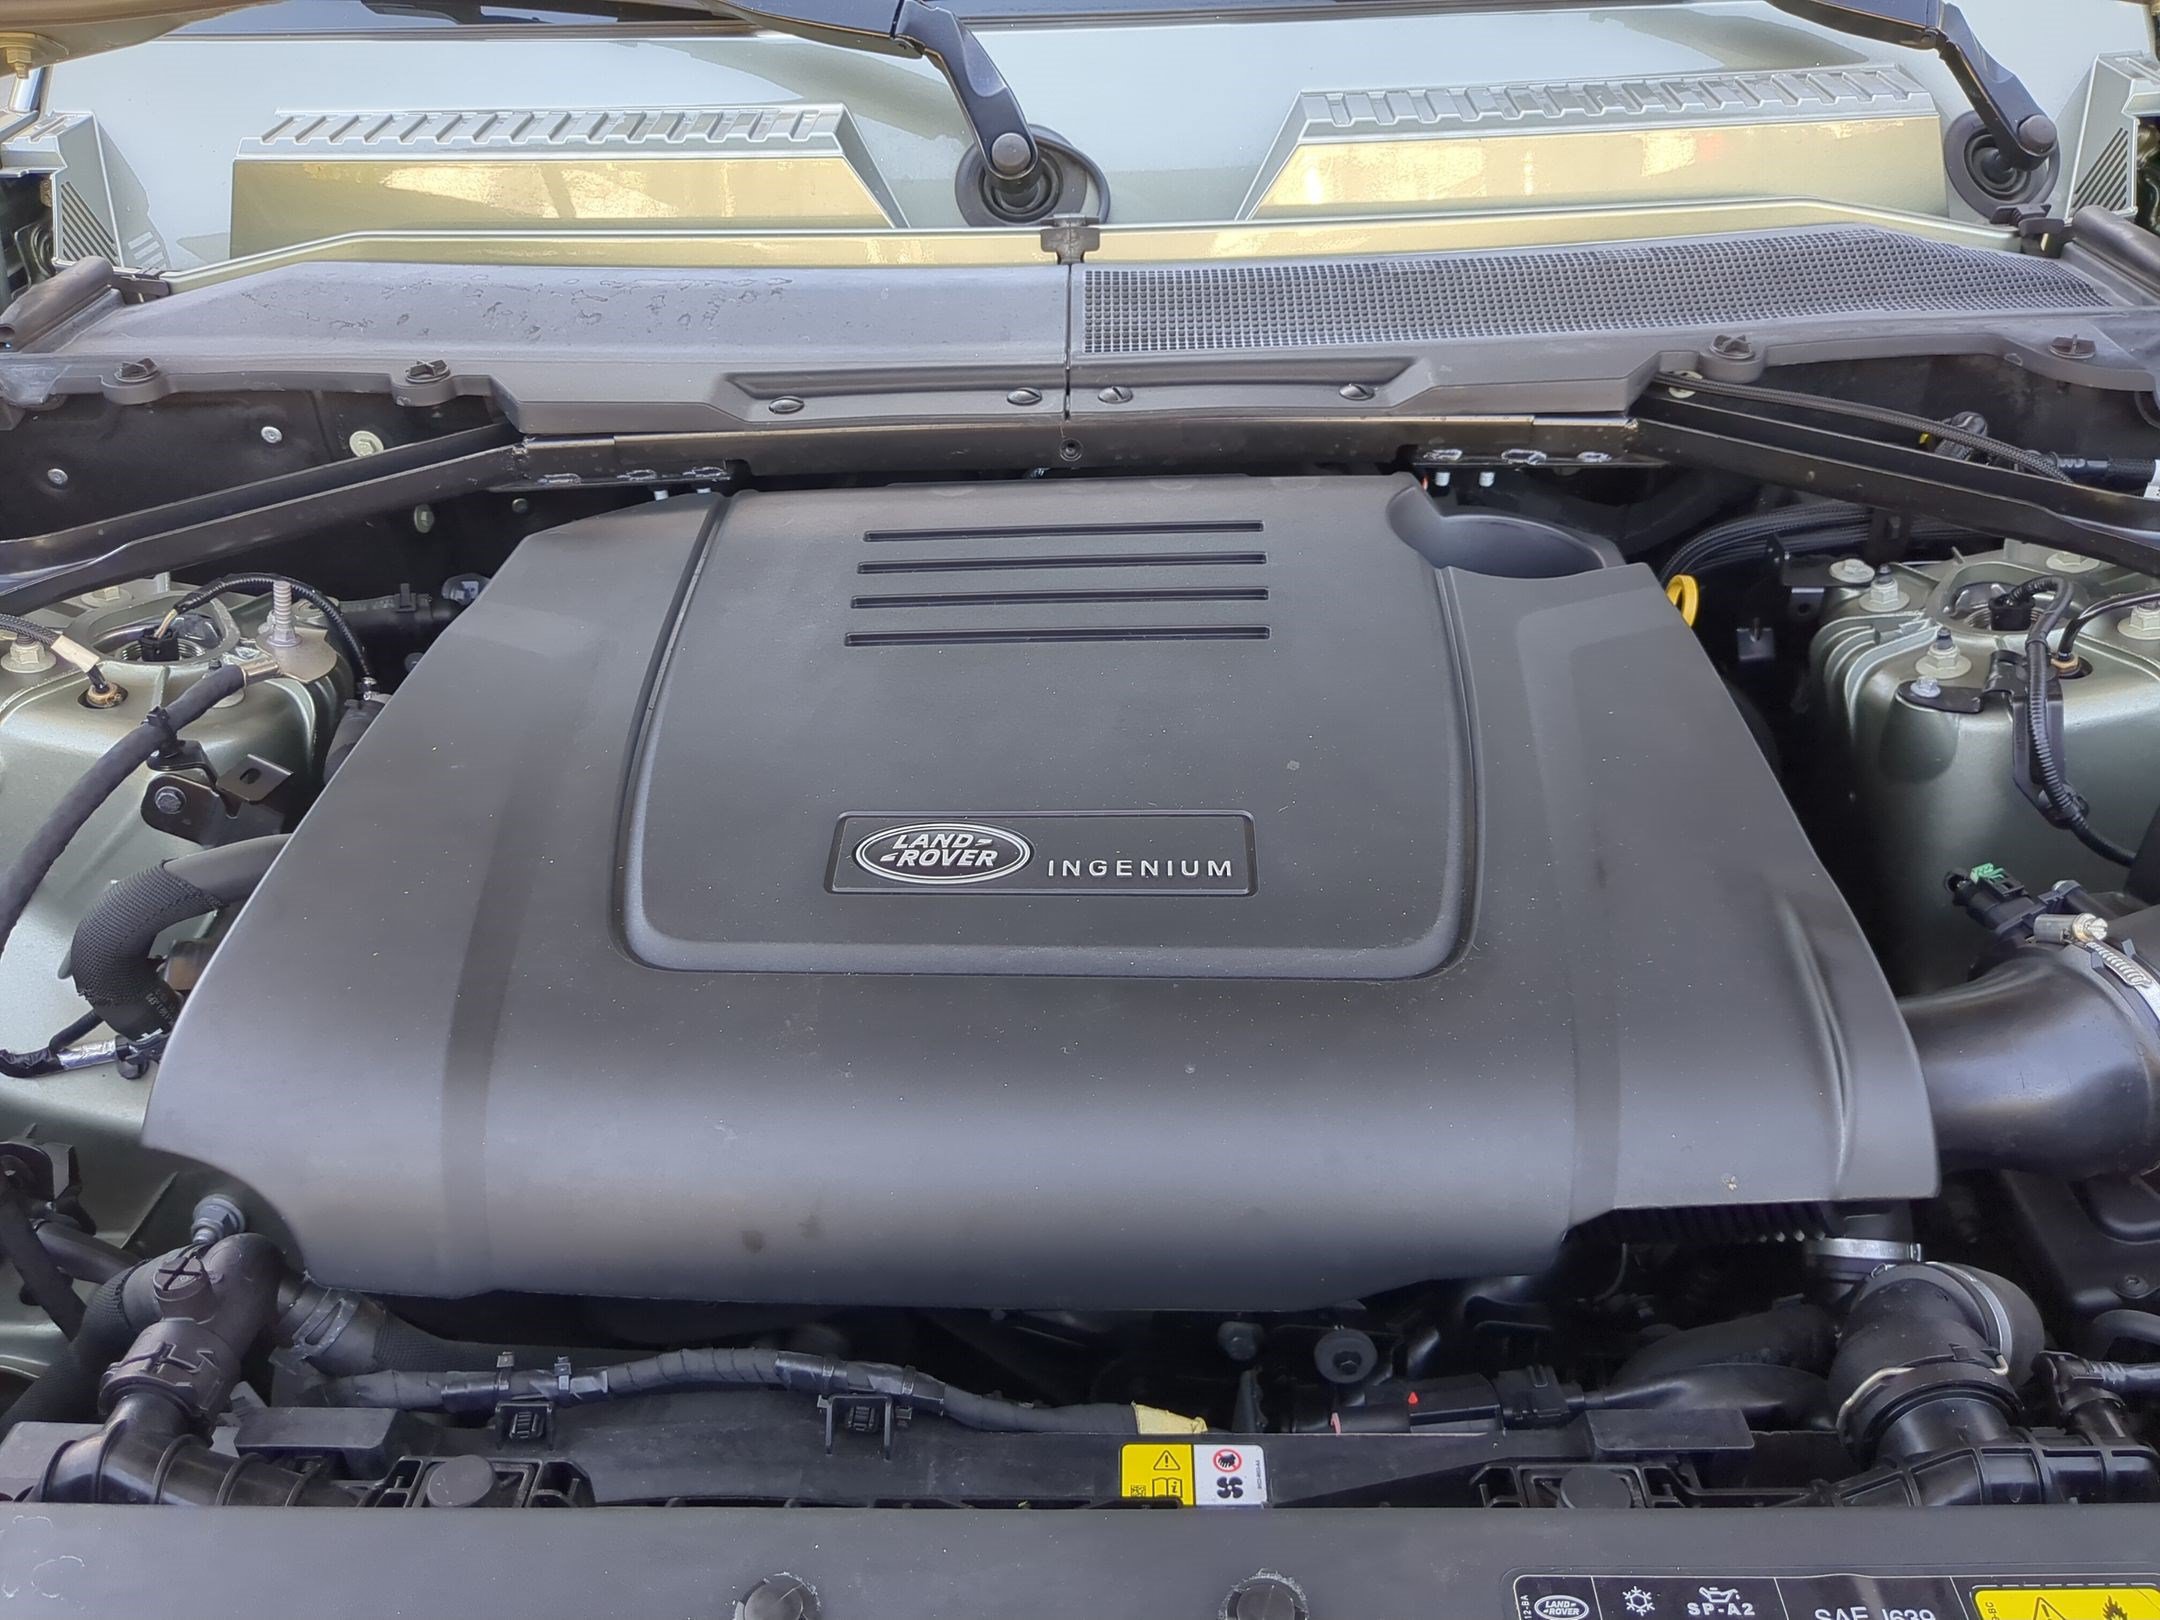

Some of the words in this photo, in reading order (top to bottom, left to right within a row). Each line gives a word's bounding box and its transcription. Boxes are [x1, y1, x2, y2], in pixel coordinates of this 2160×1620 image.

[892, 833, 976, 850] LAND
[895, 849, 999, 868] ROVER
[1047, 859, 1233, 877] INGENIUM
[1545, 1600, 1570, 1608] LAND
[1687, 1602, 1756, 1616] SP-A2
[1548, 1608, 1580, 1616] ROVER
